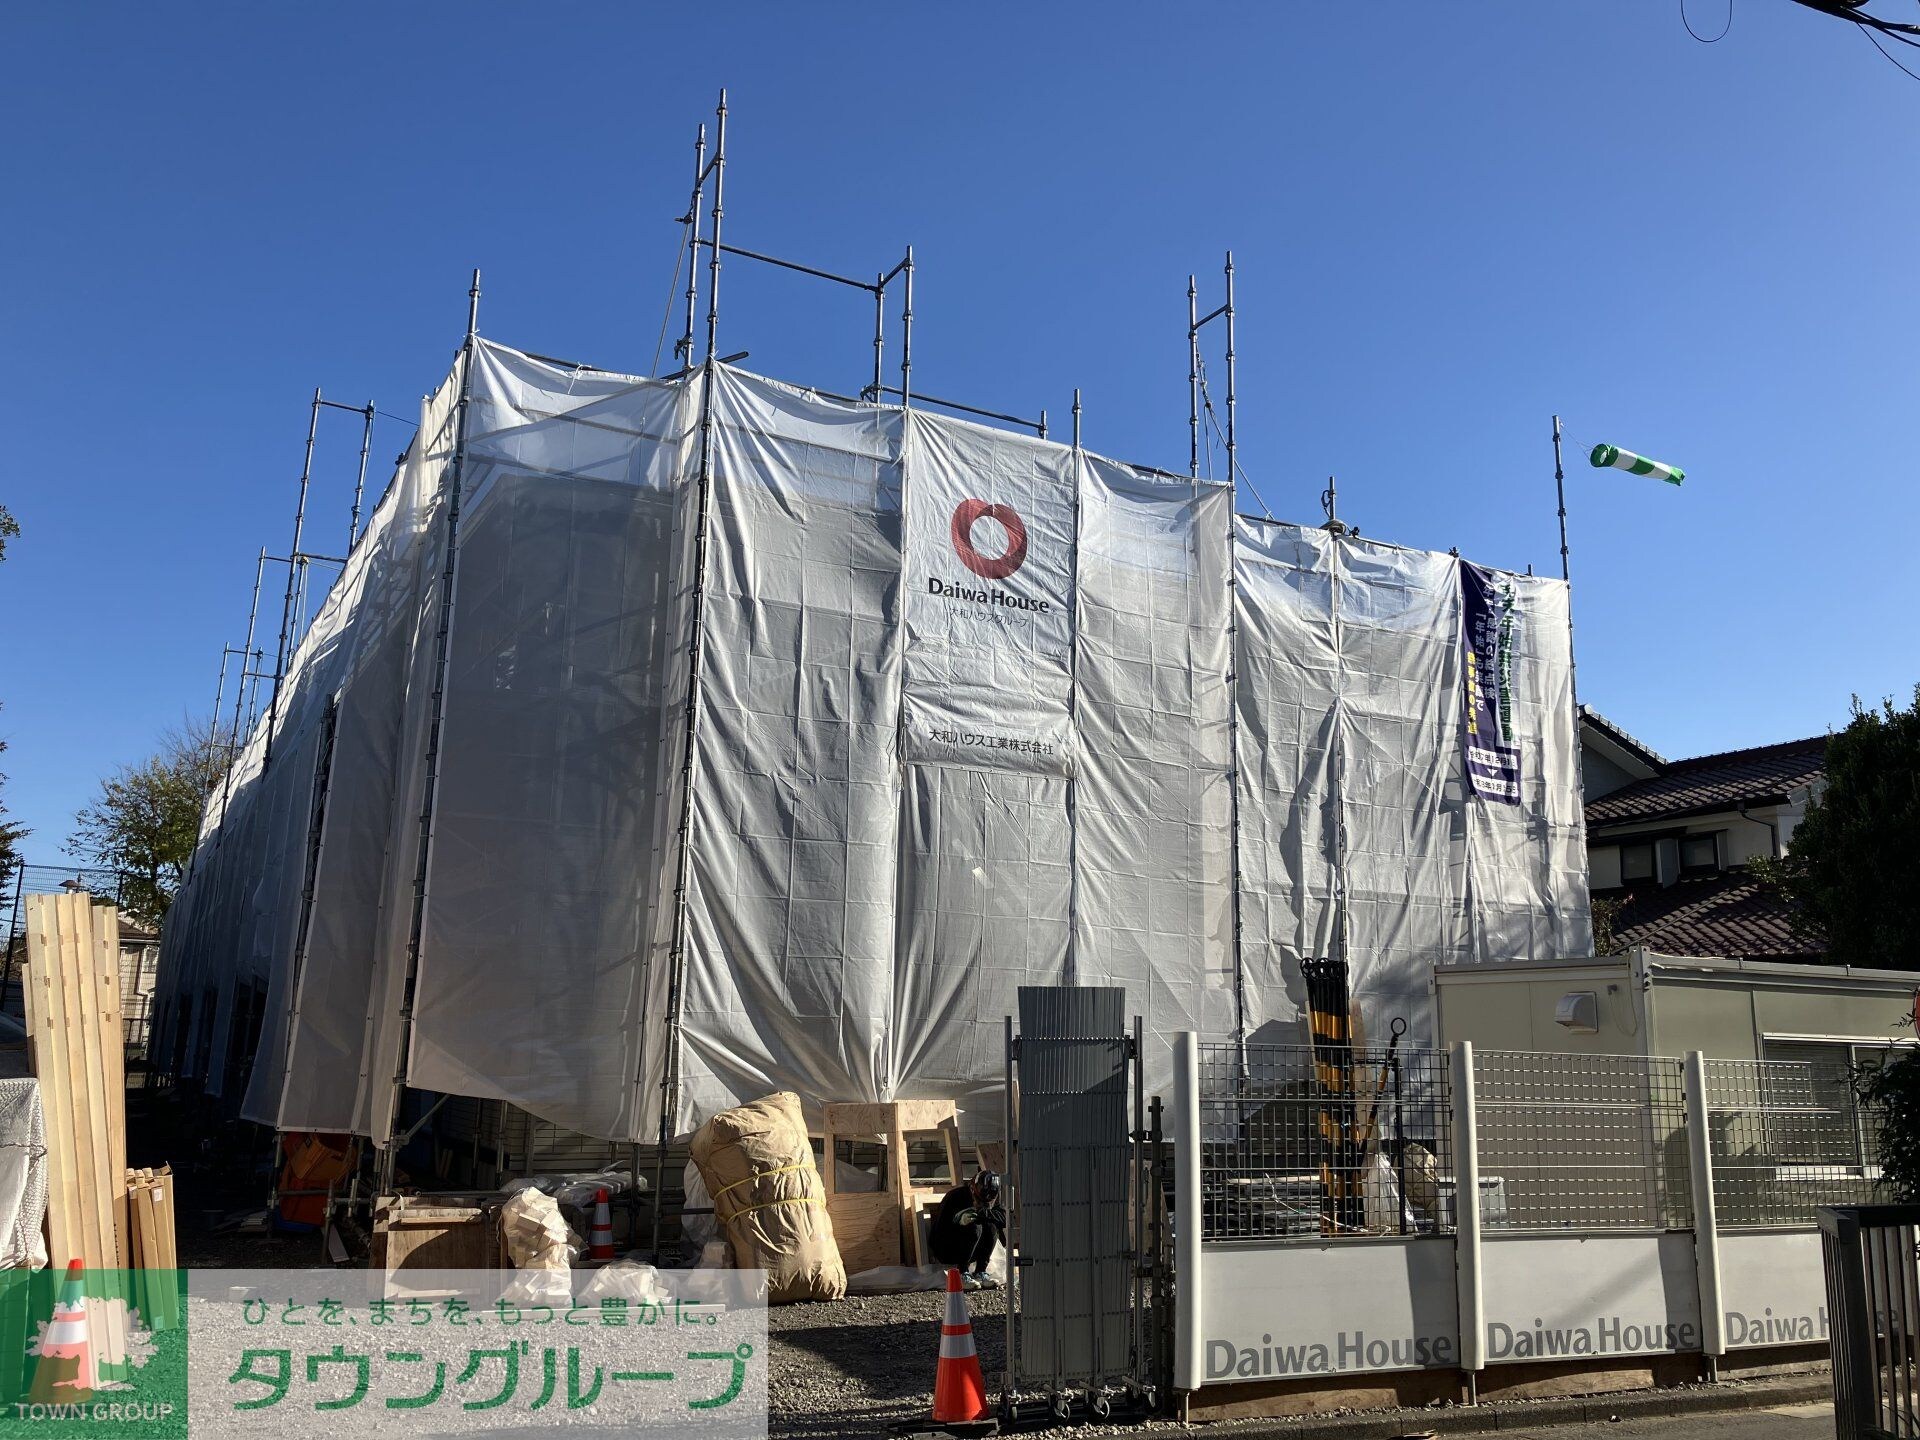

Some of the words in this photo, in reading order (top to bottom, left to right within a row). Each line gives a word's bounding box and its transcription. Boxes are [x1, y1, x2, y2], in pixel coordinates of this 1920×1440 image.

[928, 577, 988, 604] Daiwa
[990, 588, 1050, 614] House
[929, 729, 1054, 756] 大和ハウス工業株式会社
[1488, 1317, 1591, 1359] Daiwa
[1599, 1316, 1695, 1354] House
[1726, 1307, 1813, 1346] Daiwa
[1206, 1333, 1329, 1381] Daiwa
[1338, 1329, 1452, 1369] House
